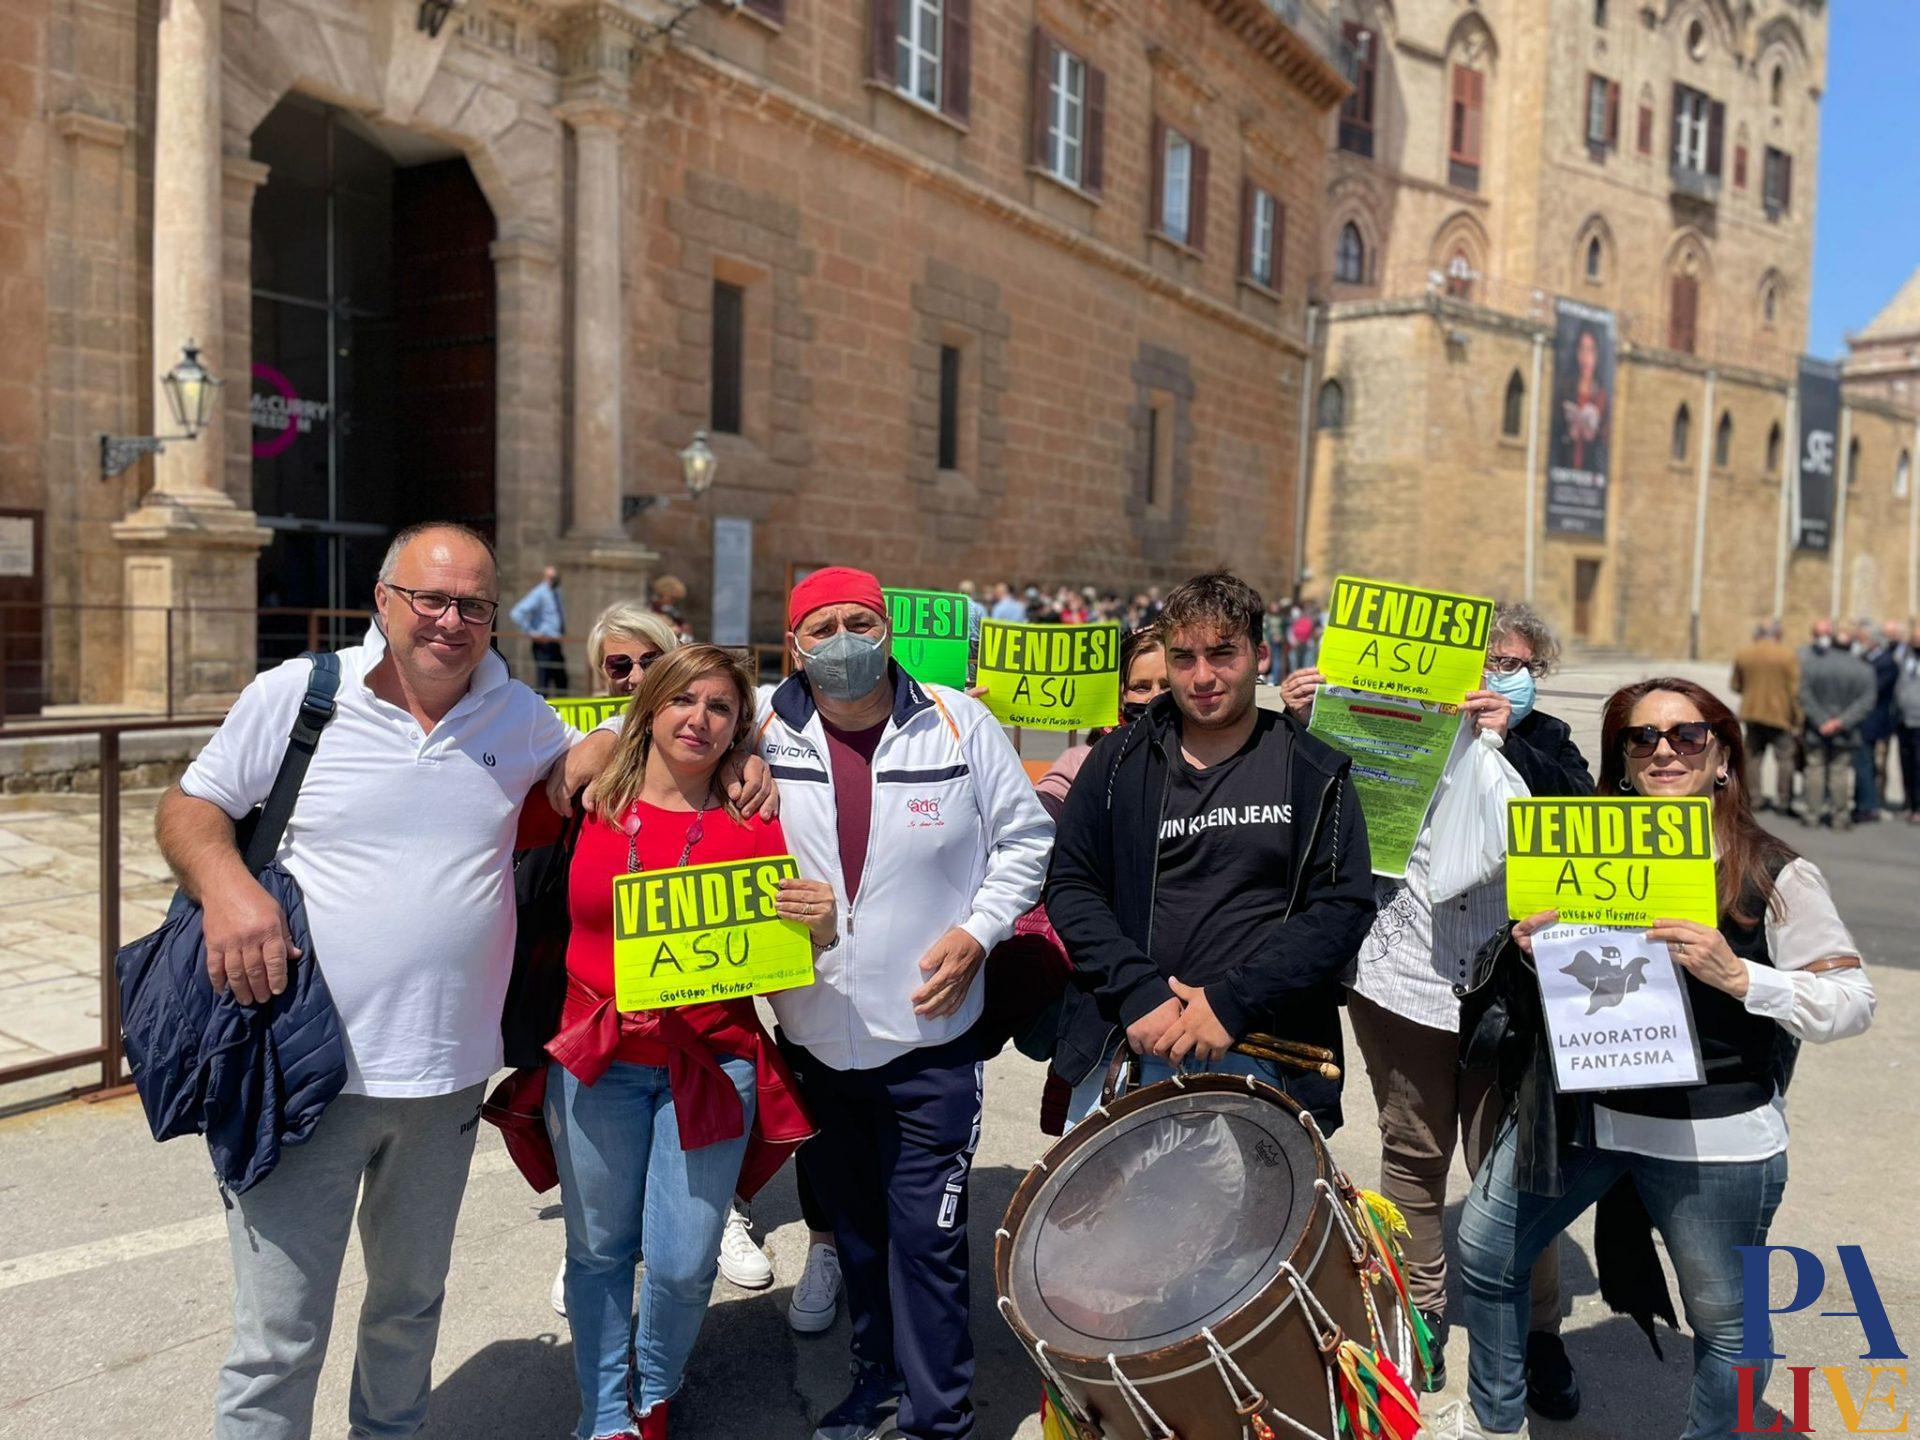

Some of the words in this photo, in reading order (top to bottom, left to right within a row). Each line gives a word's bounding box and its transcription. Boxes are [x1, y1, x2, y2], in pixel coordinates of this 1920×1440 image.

[1335, 583, 1487, 647] VENDESI
[984, 626, 1117, 673] VENDESI
[1357, 639, 1437, 675] ASU
[1012, 674, 1075, 708] ASU
[766, 744, 820, 760] GIVOVA
[1188, 807, 1237, 835] KLEIN
[1239, 804, 1292, 825] JEANS
[1511, 805, 1704, 857] VENDESI
[1556, 859, 1649, 901] ASU
[1543, 929, 1574, 940] BENI
[650, 931, 750, 977] ASU
[1559, 1025, 1678, 1048] LAVORATORI
[1571, 1050, 1674, 1070] FANTASMA
